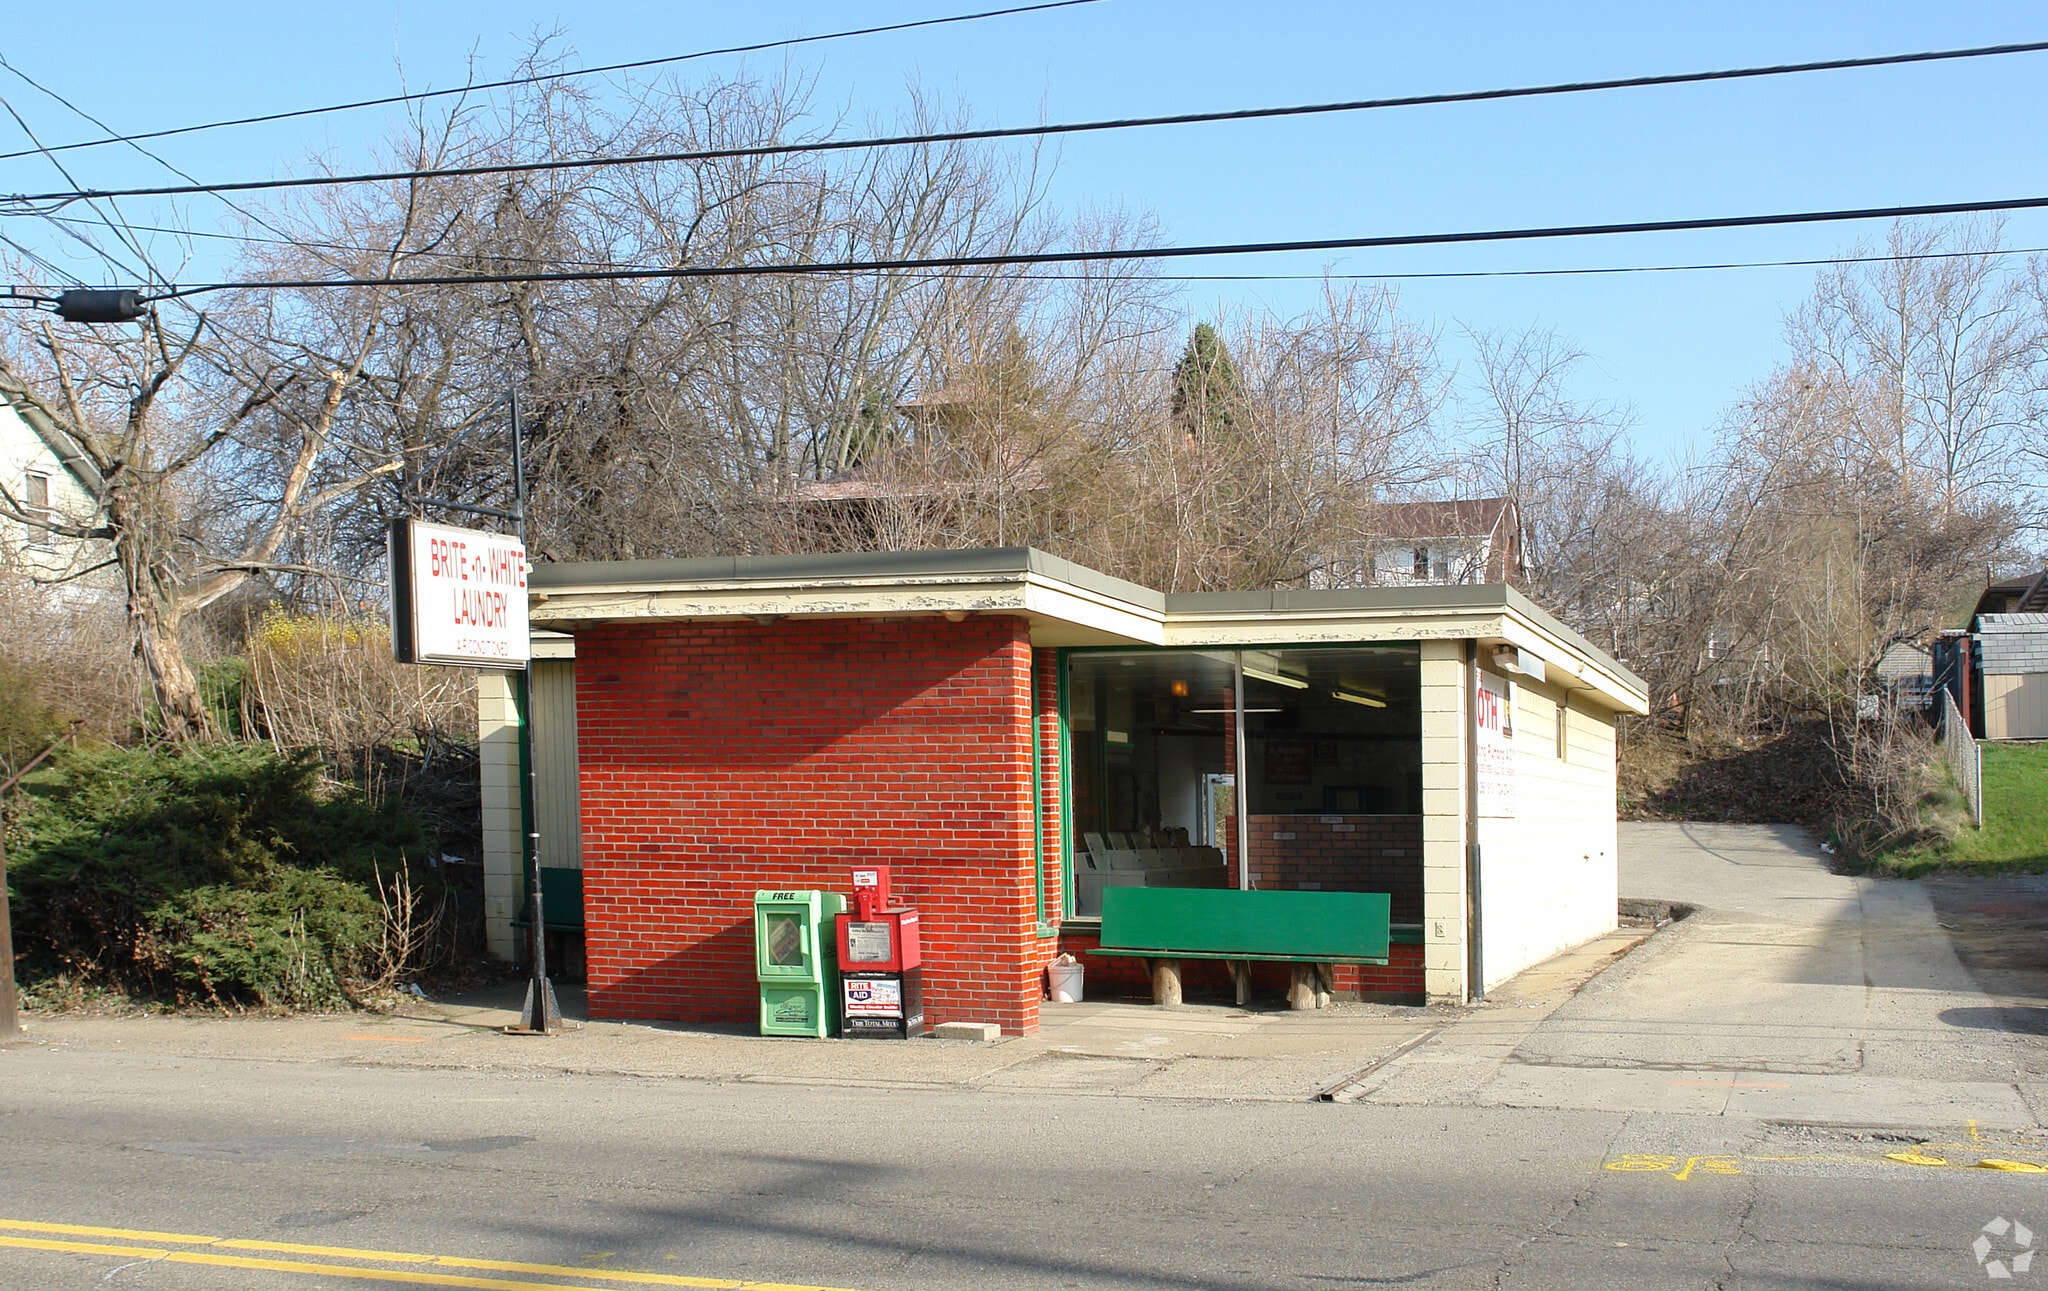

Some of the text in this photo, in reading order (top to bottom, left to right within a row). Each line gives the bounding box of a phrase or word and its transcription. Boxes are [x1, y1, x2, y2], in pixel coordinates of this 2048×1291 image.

[431, 538, 468, 580] BRITE
[488, 547, 525, 588] WHITE
[453, 587, 508, 629] LAUNDRY
[772, 892, 795, 901] FREE
[850, 982, 869, 990] RITE
[853, 991, 868, 999] AID
